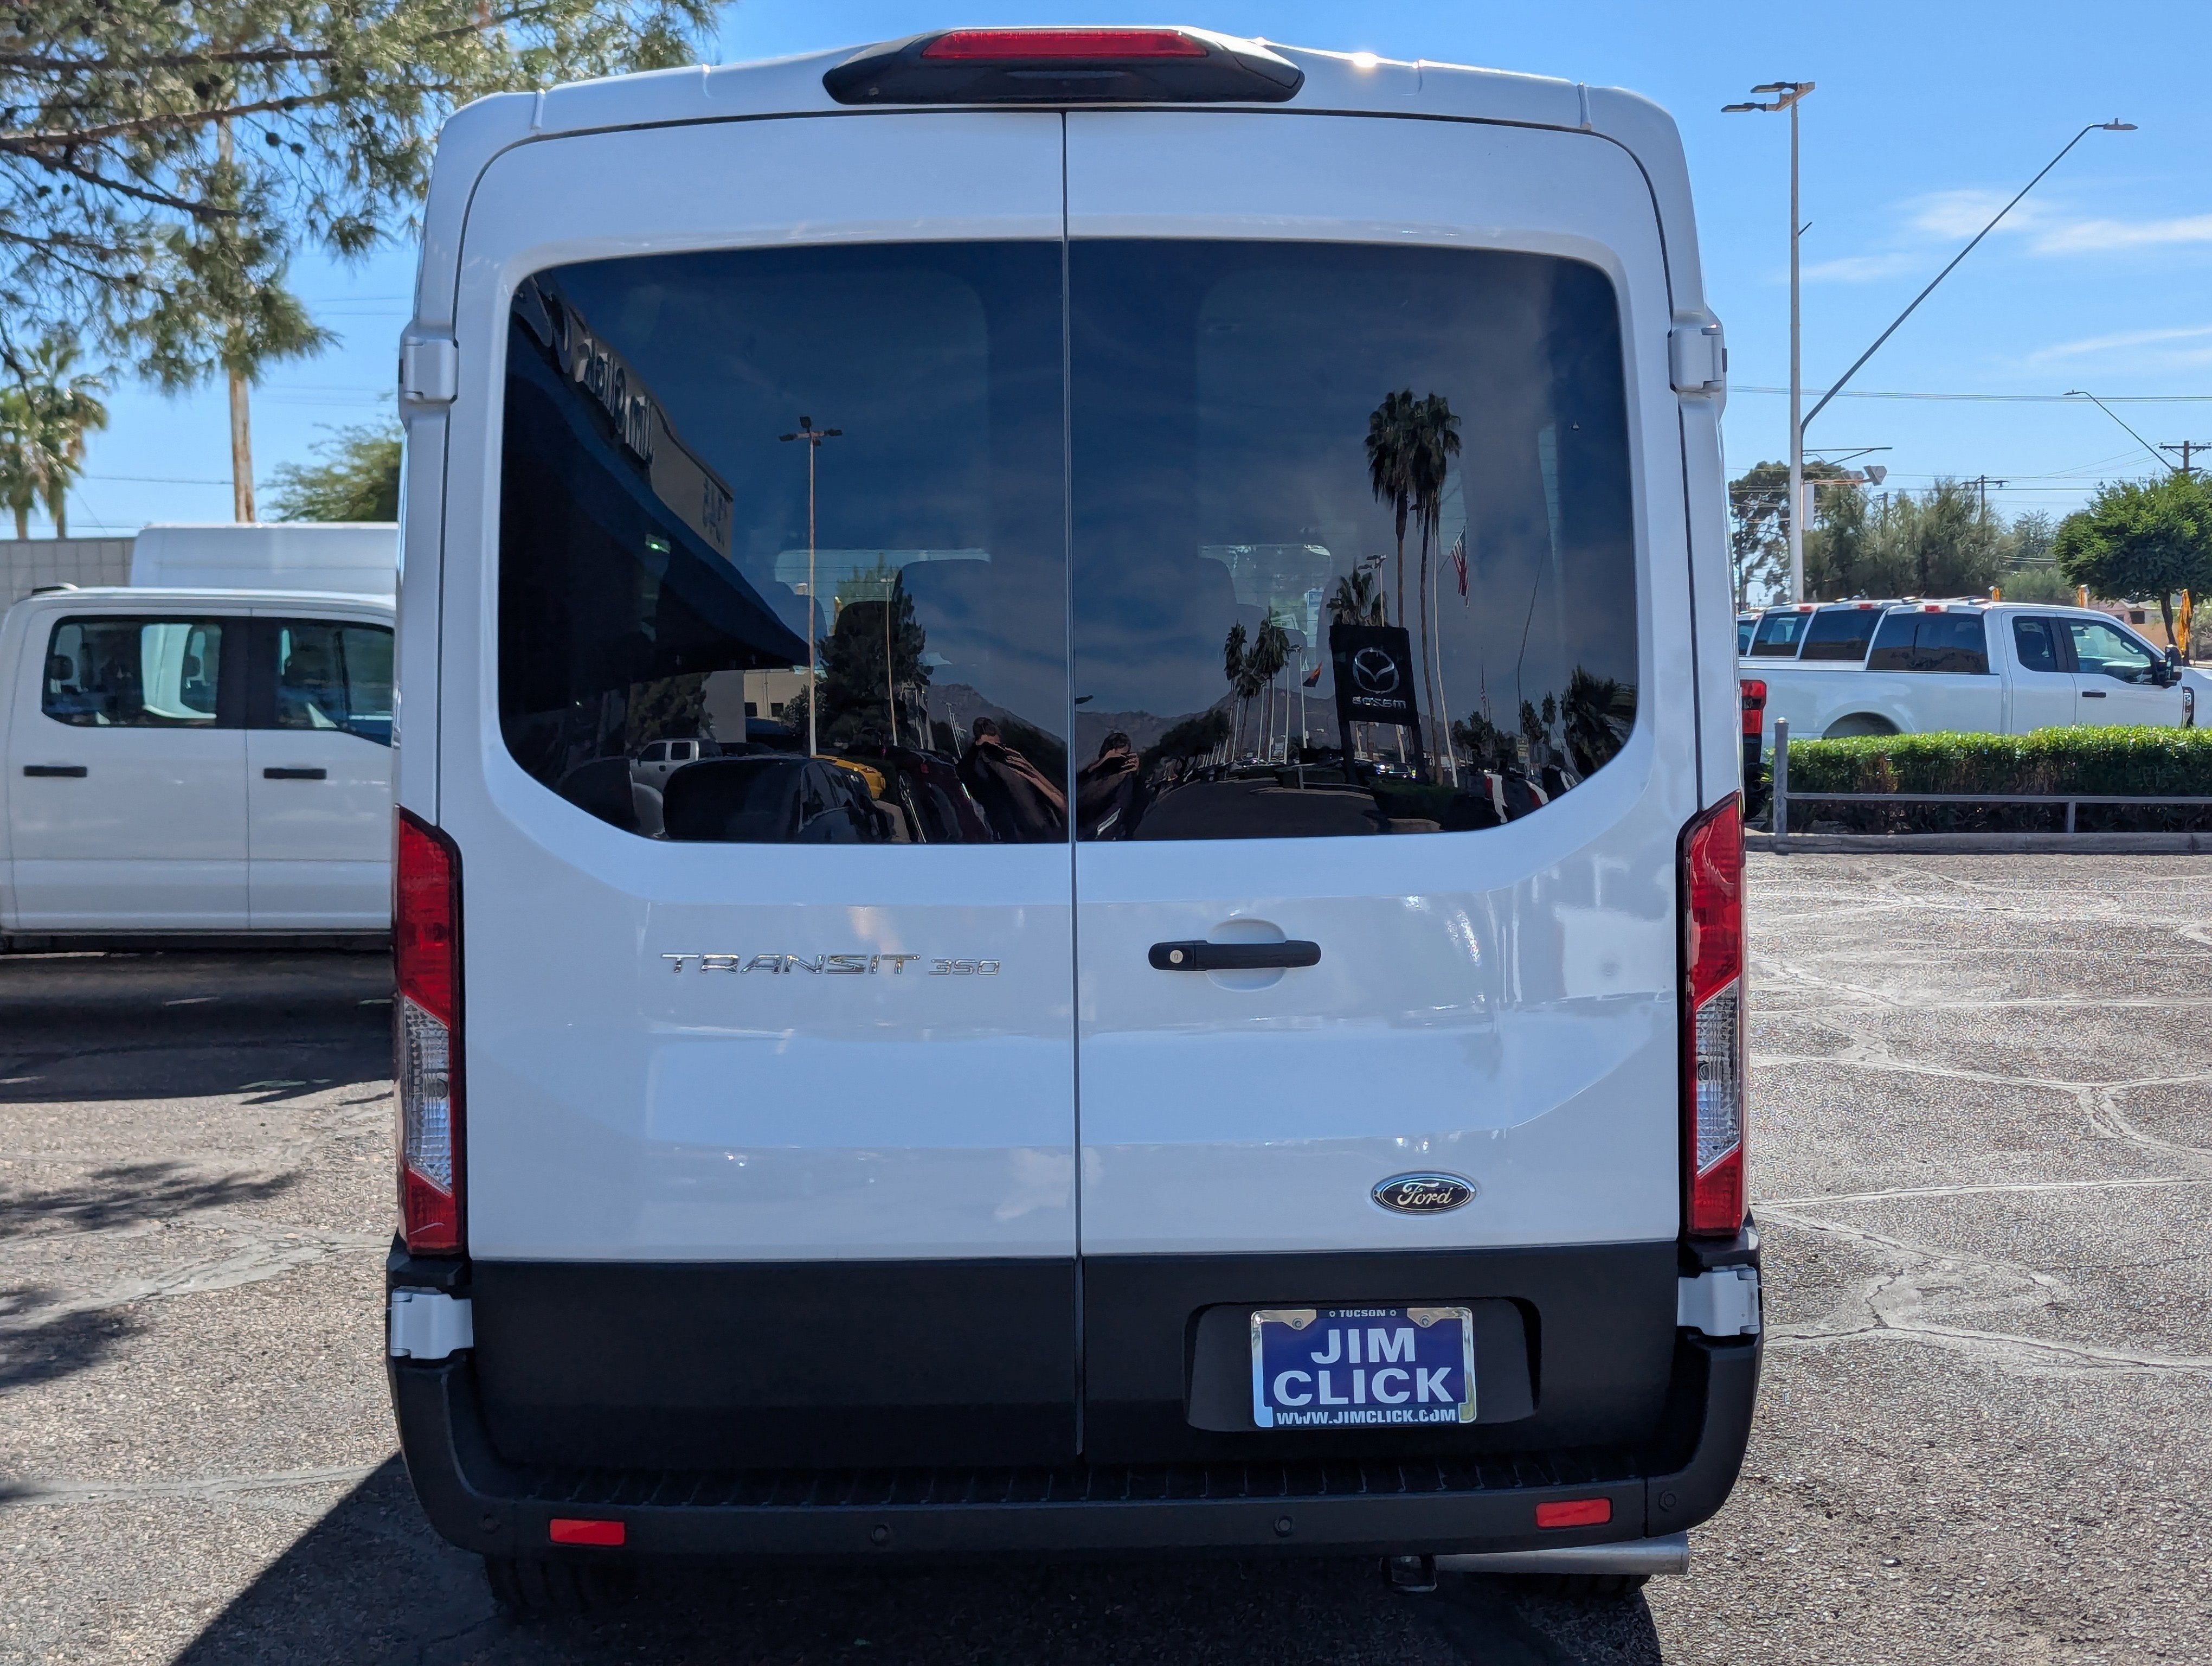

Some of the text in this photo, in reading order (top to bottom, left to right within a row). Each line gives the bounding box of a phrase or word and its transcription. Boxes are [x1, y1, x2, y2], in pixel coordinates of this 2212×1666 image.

[660, 953, 1001, 975] TRANSIT 350
[1397, 1181, 1454, 1206] Ford
[1339, 1309, 1386, 1318] TUCSON
[1310, 1328, 1416, 1364] JIM
[1273, 1367, 1454, 1406] CLICK
[1276, 1408, 1457, 1425] WWW.JIMCLICK.COM
